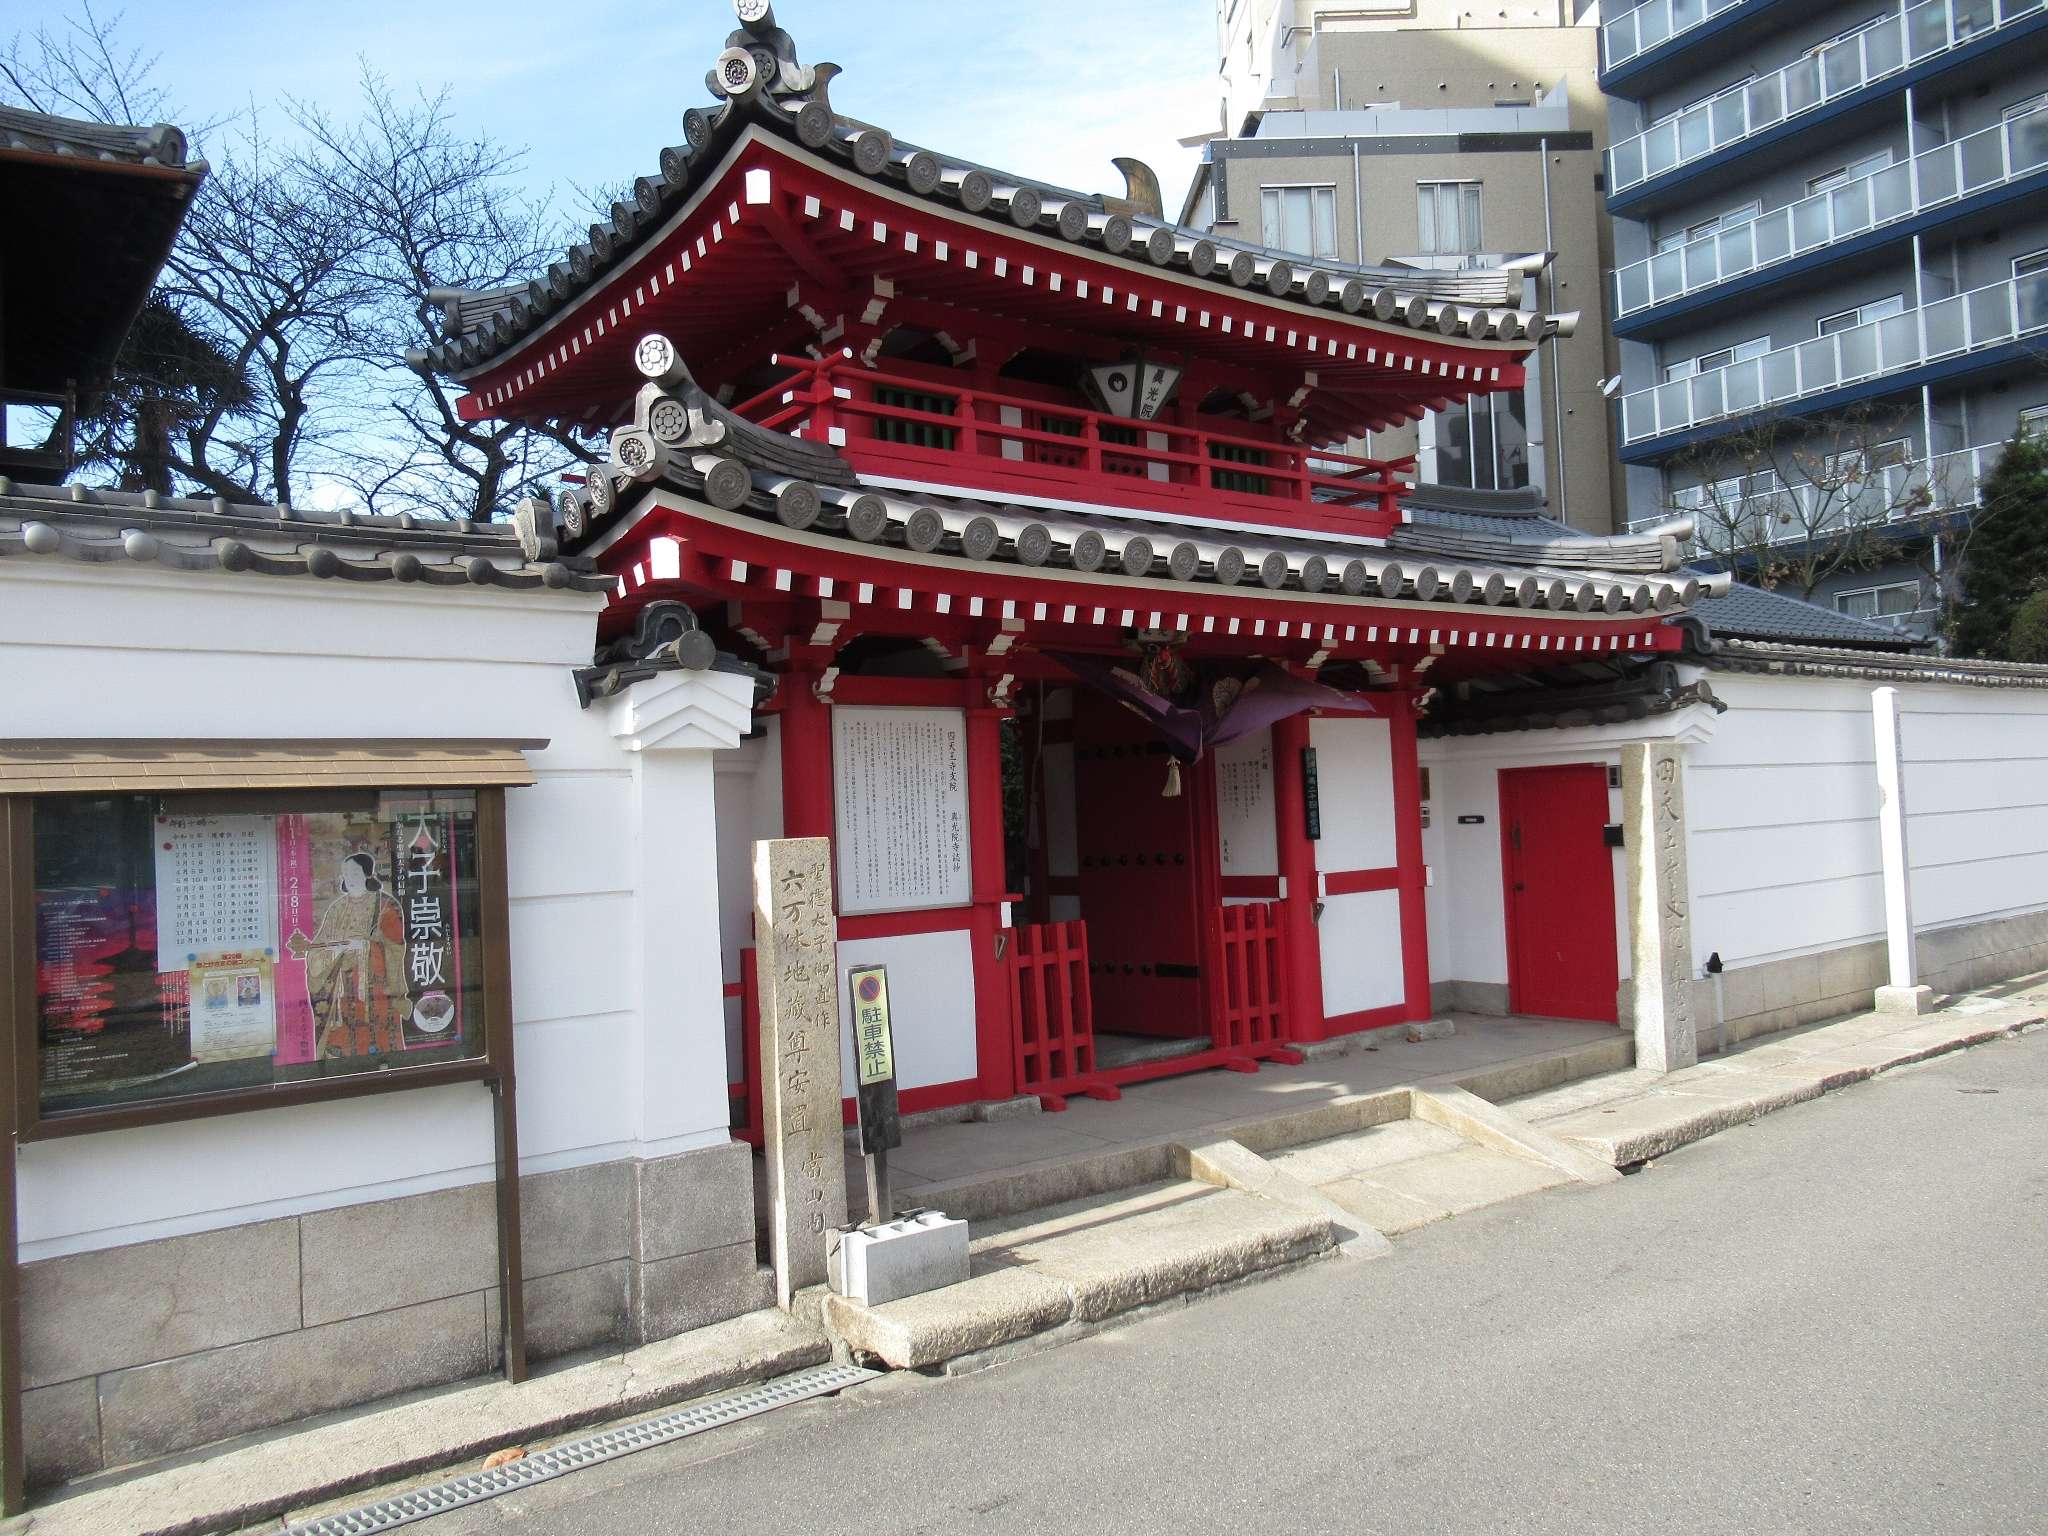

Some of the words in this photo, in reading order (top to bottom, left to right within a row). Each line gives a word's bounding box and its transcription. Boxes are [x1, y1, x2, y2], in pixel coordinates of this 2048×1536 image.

[408, 806, 446, 986] 太子崇敬
[861, 1006, 888, 1079] 駐車禁止
